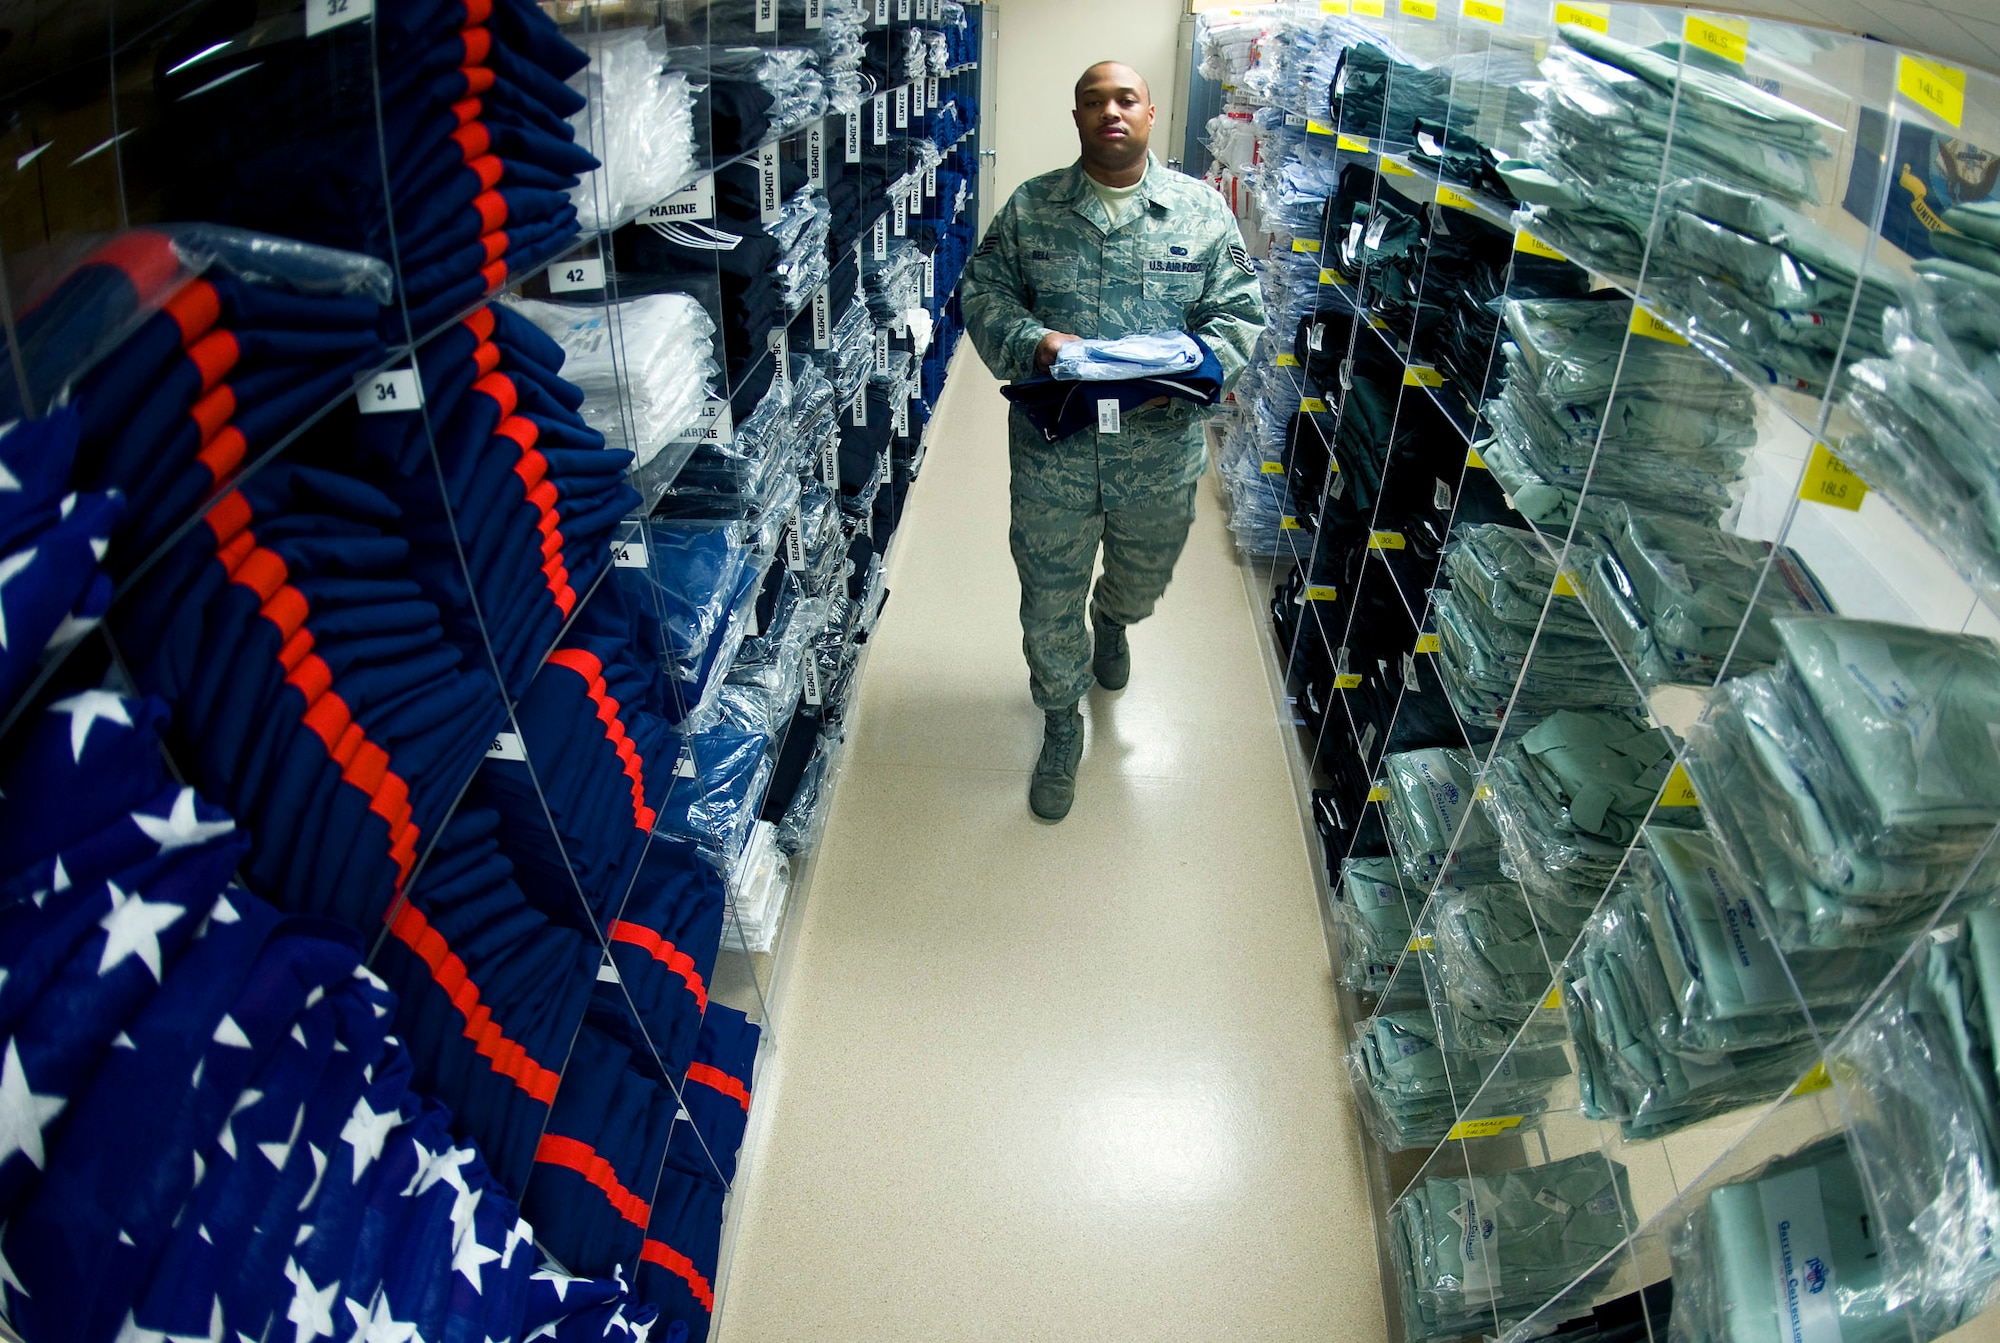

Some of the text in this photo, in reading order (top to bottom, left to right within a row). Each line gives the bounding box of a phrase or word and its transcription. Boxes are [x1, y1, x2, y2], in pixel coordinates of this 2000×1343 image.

[326, 0, 347, 16] 32
[1569, 13, 1592, 28] 19LS
[1701, 29, 1729, 49] 16LS
[1917, 78, 1945, 106] 14LS
[849, 112, 857, 155] 46 JUMPER
[811, 130, 820, 180] 42 JUMPER
[763, 154, 775, 211] 34 JUMPER
[1448, 192, 1463, 202] 31L
[649, 203, 697, 217] MARINE
[1032, 250, 1050, 261] BELL
[566, 268, 585, 283] 42
[1149, 260, 1165, 271] U.S.
[1165, 261, 1182, 272] AIR
[815, 294, 825, 341] 44 JUMPER
[773, 343, 782, 355] 36
[375, 383, 397, 400] 34
[680, 427, 718, 439] ARINE
[827, 451, 835, 482] JUMPER
[1820, 480, 1848, 500] 18LS
[790, 528, 800, 562] JUMPER
[807, 669, 816, 697] JUMPER
[1436, 792, 1453, 833] Collection
[1727, 908, 1751, 968] Collection
[1467, 1119, 1506, 1129] FEMALE
[1779, 1220, 1793, 1277] Garrison
